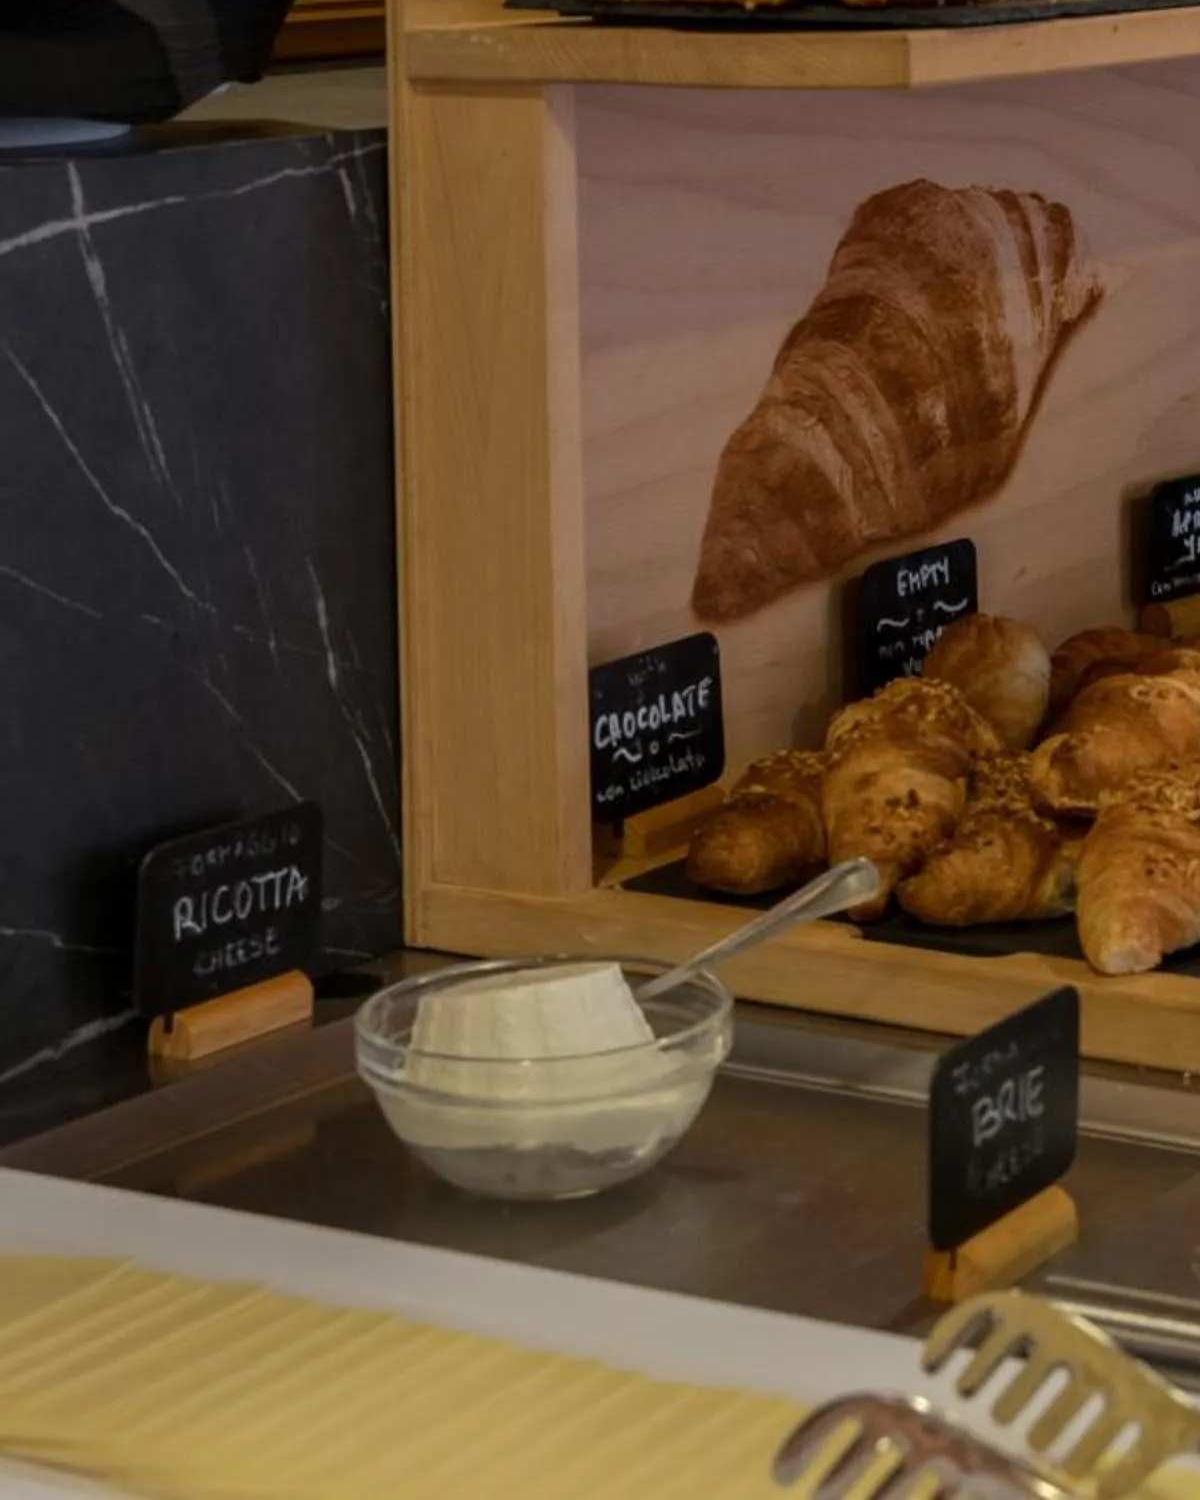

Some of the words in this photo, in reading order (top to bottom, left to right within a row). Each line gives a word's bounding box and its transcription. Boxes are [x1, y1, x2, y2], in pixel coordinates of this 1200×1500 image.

[897, 556, 949, 596] EMPTY
[174, 865, 307, 940] RICOTTA
[971, 1065, 1045, 1148] BRIE
